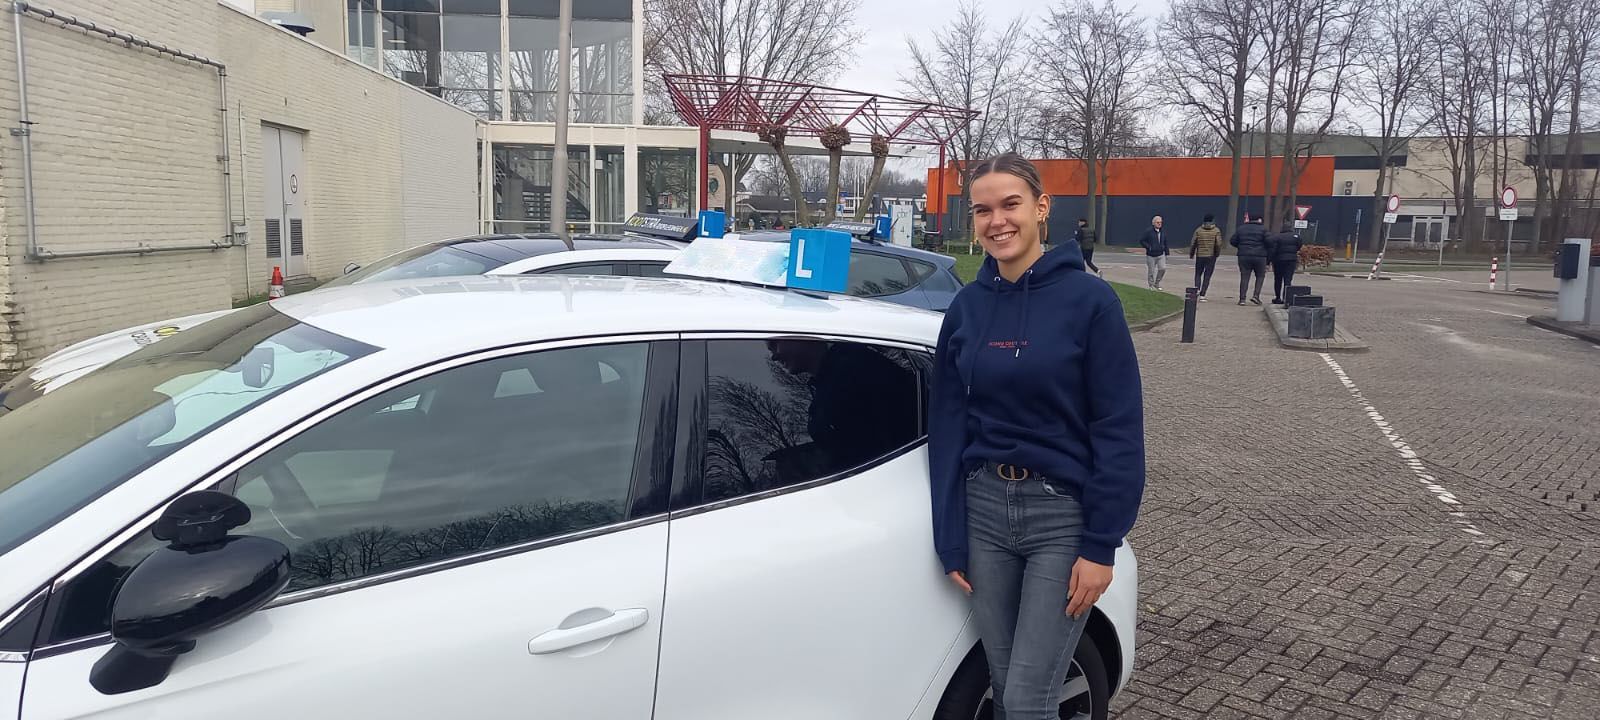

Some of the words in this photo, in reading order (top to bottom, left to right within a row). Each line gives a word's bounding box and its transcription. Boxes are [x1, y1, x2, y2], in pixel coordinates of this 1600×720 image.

[701, 215, 710, 236] L
[876, 219, 883, 234] L
[795, 239, 812, 278] L
